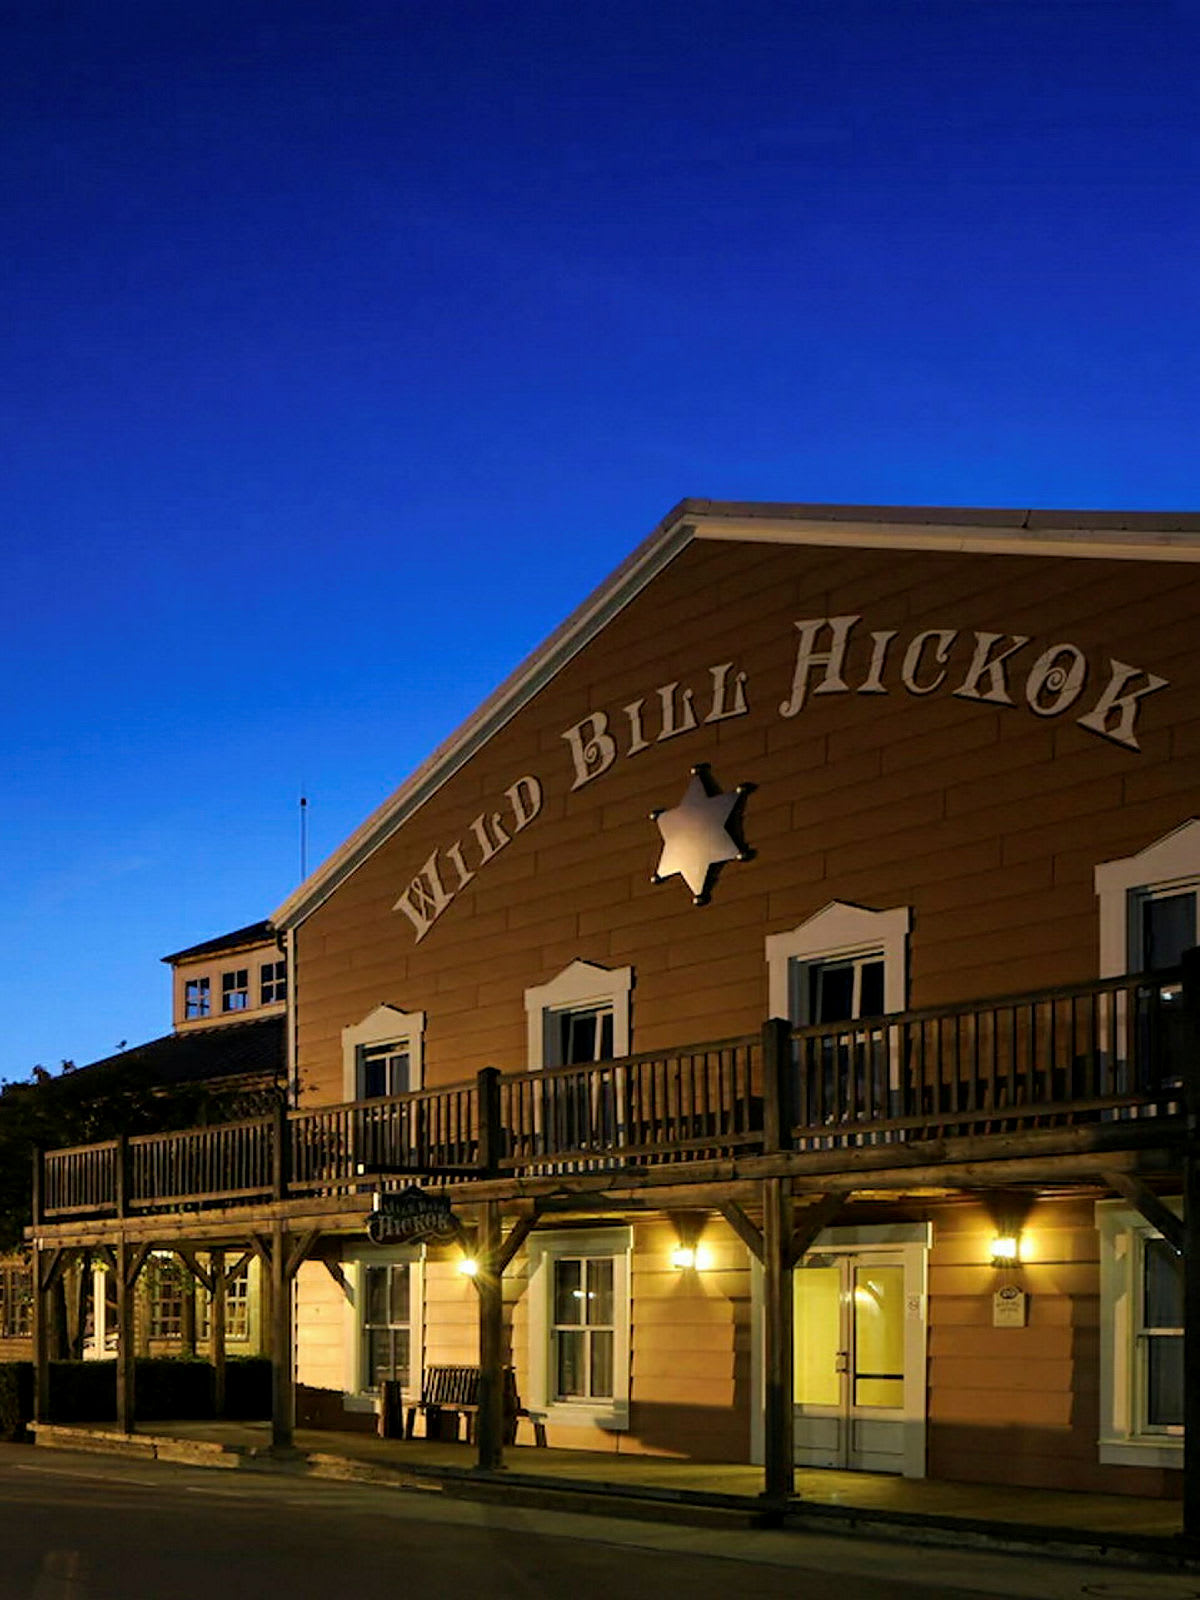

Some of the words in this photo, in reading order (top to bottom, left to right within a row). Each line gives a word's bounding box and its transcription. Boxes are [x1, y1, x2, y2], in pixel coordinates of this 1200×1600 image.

[392, 773, 543, 944] WILD
[560, 661, 750, 793] BILL
[778, 614, 1170, 753] HICKOK
